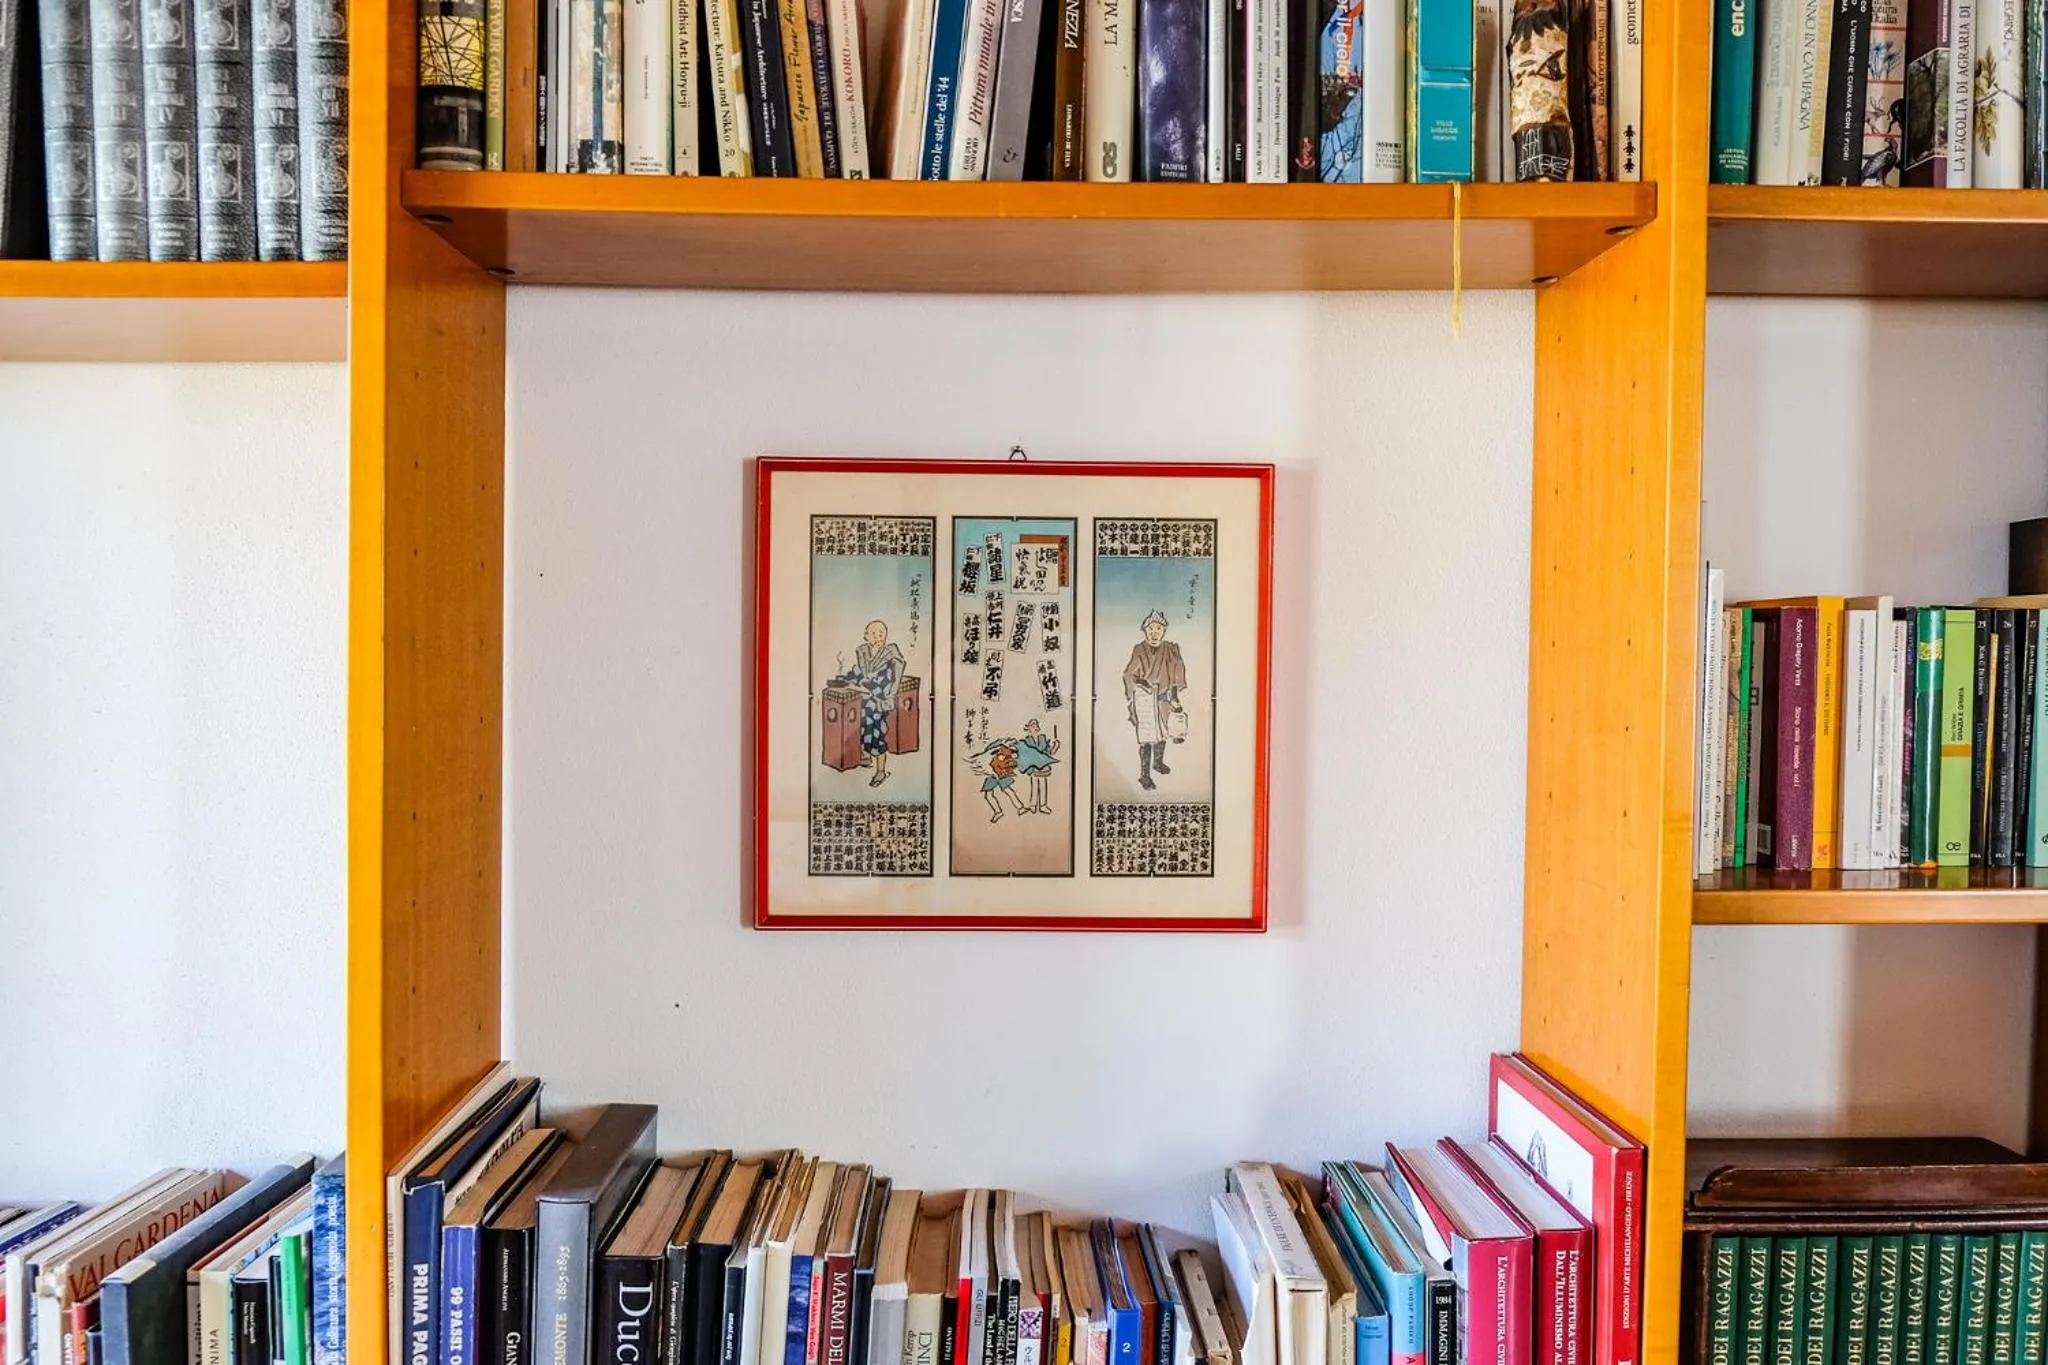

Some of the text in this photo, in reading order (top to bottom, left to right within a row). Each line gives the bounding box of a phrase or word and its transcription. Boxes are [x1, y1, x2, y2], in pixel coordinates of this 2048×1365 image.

[751, 11, 763, 47] Japanese
[1103, 24, 1118, 46] LA
[1848, 20, 1858, 54] L'UOMO
[1958, 5, 1971, 19] DI
[489, 13, 502, 119] YOUR GARDEN
[678, 38, 690, 58] Art:
[714, 43, 726, 84] Katsura
[787, 30, 801, 67] Flower
[967, 1, 997, 125] Pittura murale in
[1336, 17, 1352, 78] il cielo
[1847, 56, 1855, 73] CHE
[1955, 22, 1970, 77] AGRARIA
[676, 61, 691, 109] Horyu-ji
[718, 87, 729, 108] and
[755, 49, 769, 100] Architecture
[792, 73, 809, 122] Japanese
[842, 49, 855, 102] KOKORO
[937, 77, 950, 93] '44
[1800, 32, 1816, 132] IN CAMPAGNA
[1845, 76, 1855, 109] CURAVA
[1955, 81, 1968, 94] DI
[721, 110, 734, 142] Nikko
[933, 113, 946, 142] stelle
[936, 94, 948, 112] del
[1844, 112, 1852, 129] CON
[931, 143, 943, 154] le
[1843, 138, 1851, 161] FIORI
[1953, 157, 1966, 172] LA
[1795, 617, 1803, 641] Adorno
[113, 1183, 226, 1262] GARDENA
[556, 1246, 570, 1301] 1865-1895
[1623, 1171, 1633, 1329] EDIZIONI D'ARTE MICHELANGELO FIRENZE
[412, 1263, 429, 1325] PRIMA
[450, 1287, 464, 1305] 99
[831, 1272, 848, 1329] MARMI
[1496, 1256, 1508, 1341] L'ARCHITETTURA
[1554, 1249, 1567, 1348] DALL'ILLUMINISMO
[1567, 1249, 1579, 1337] L'ARCHITETTURA
[1714, 1247, 1733, 1330] RAGAZZI
[1748, 1248, 1767, 1330] RAGAZZI
[1778, 1249, 1797, 1331] RAGAZZI
[1809, 1247, 1828, 1329] RAGAZZI
[1849, 1248, 1868, 1330] RAGAZZI
[1878, 1247, 1897, 1329] RAGAZZI
[1906, 1244, 1926, 1362] DEI RAGAZZI
[1934, 1245, 1955, 1363] DEI RAGAZZI
[1966, 1247, 1988, 1365] DEI RAGAZZI
[1994, 1243, 2015, 1362] DEI RAGAZZI
[2023, 1242, 2044, 1360] DEI RAGAZZI
[450, 1310, 463, 1351] PASSI
[616, 1281, 654, 1365] Duc
[904, 1330, 918, 1357] Kemp
[985, 1313, 996, 1356] The Land of
[1005, 1296, 1018, 1356] PIERO DELLA
[1122, 1342, 1132, 1353] 2
[1161, 1312, 1172, 1343] Urbino
[1439, 1310, 1449, 1361] IMMAGINI
